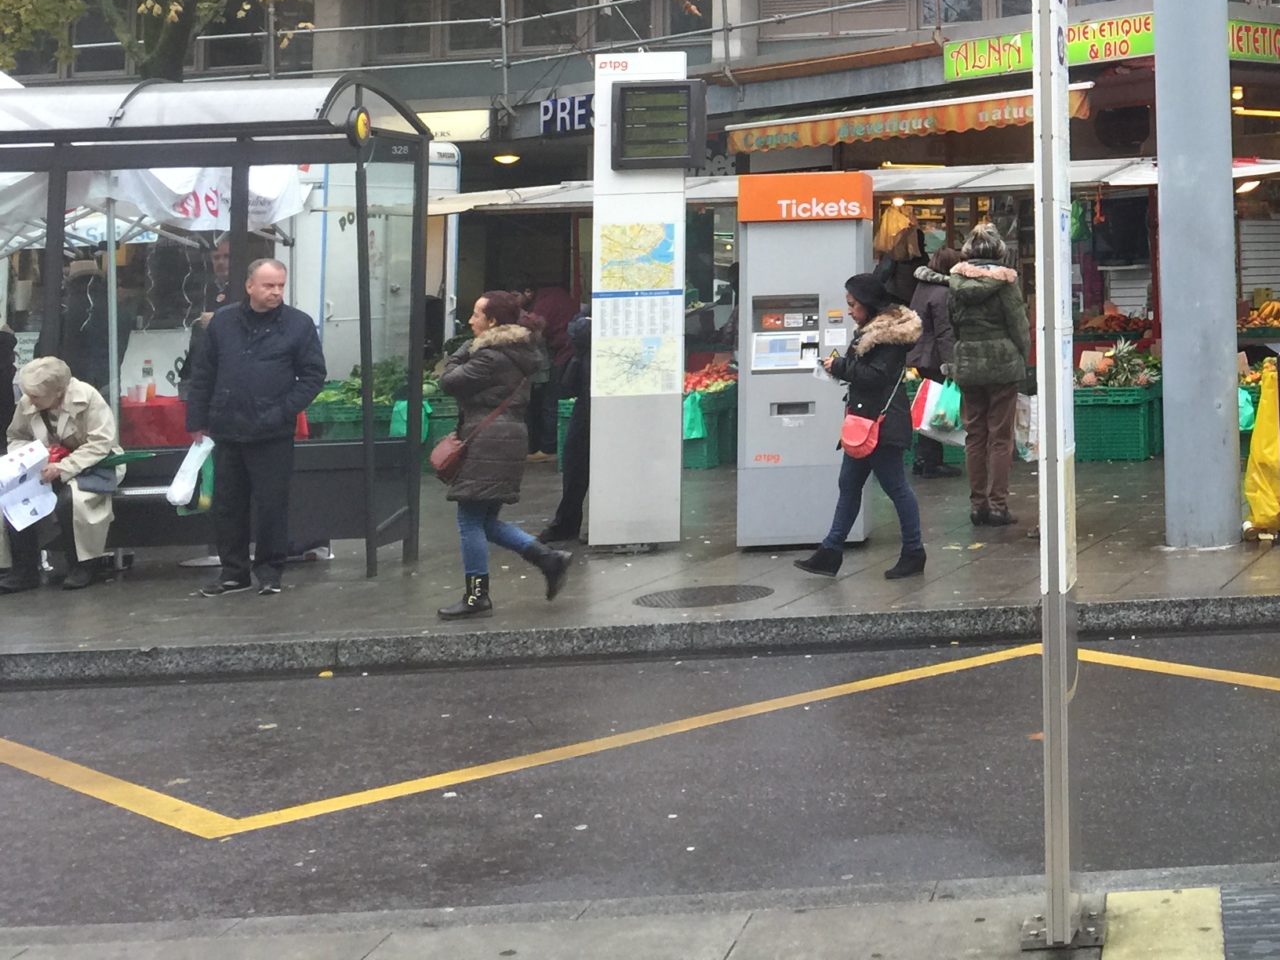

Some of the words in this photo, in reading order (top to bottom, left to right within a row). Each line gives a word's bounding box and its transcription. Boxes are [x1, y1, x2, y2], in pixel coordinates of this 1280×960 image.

[1089, 44, 1100, 60] &
[1103, 40, 1130, 58] BIO
[608, 61, 628, 71] tpg
[391, 145, 409, 155] 328
[777, 197, 860, 218] Tickets
[763, 454, 781, 463] tpg
